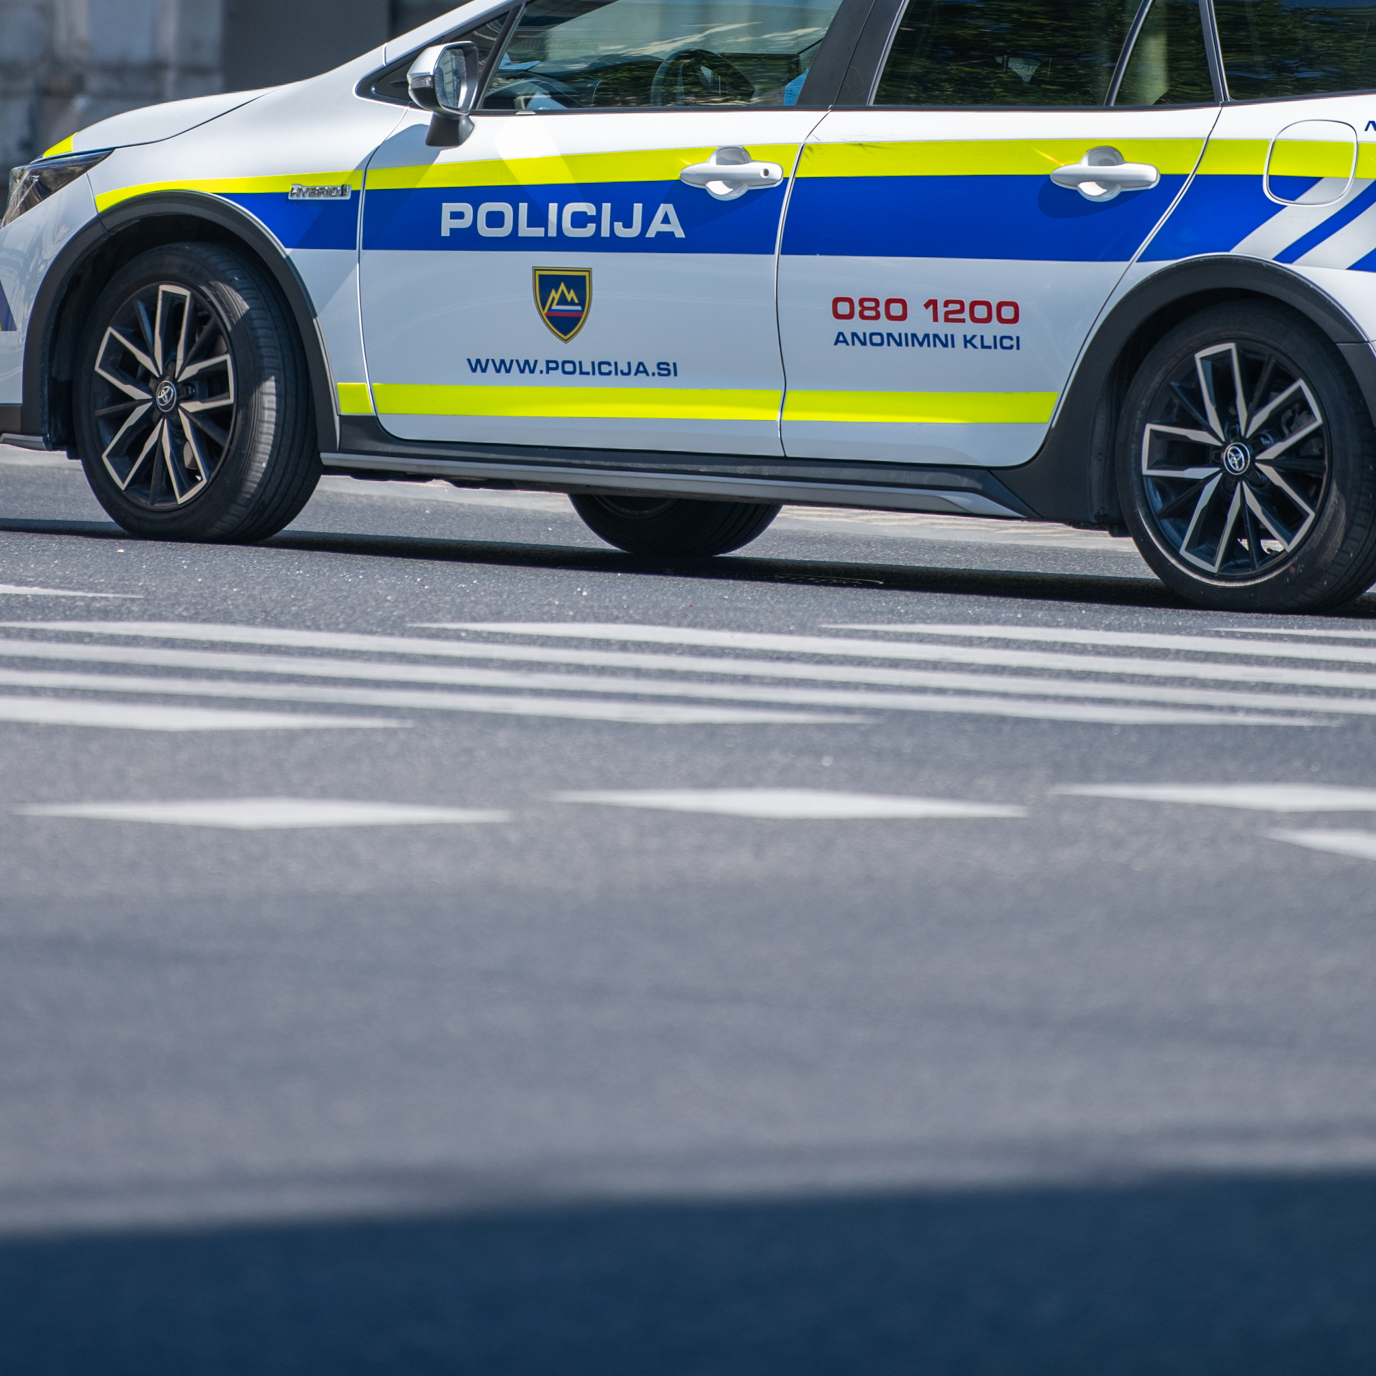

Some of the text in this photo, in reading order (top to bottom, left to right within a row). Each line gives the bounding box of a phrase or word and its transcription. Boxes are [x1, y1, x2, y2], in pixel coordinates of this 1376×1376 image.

[290, 185, 342, 198] HYBRID
[440, 201, 686, 239] POLICIJA
[831, 296, 1020, 325] 080 1200
[833, 331, 1021, 351] ANONIMNI KLICI
[466, 357, 679, 378] WWW.POLICIJA.SI
